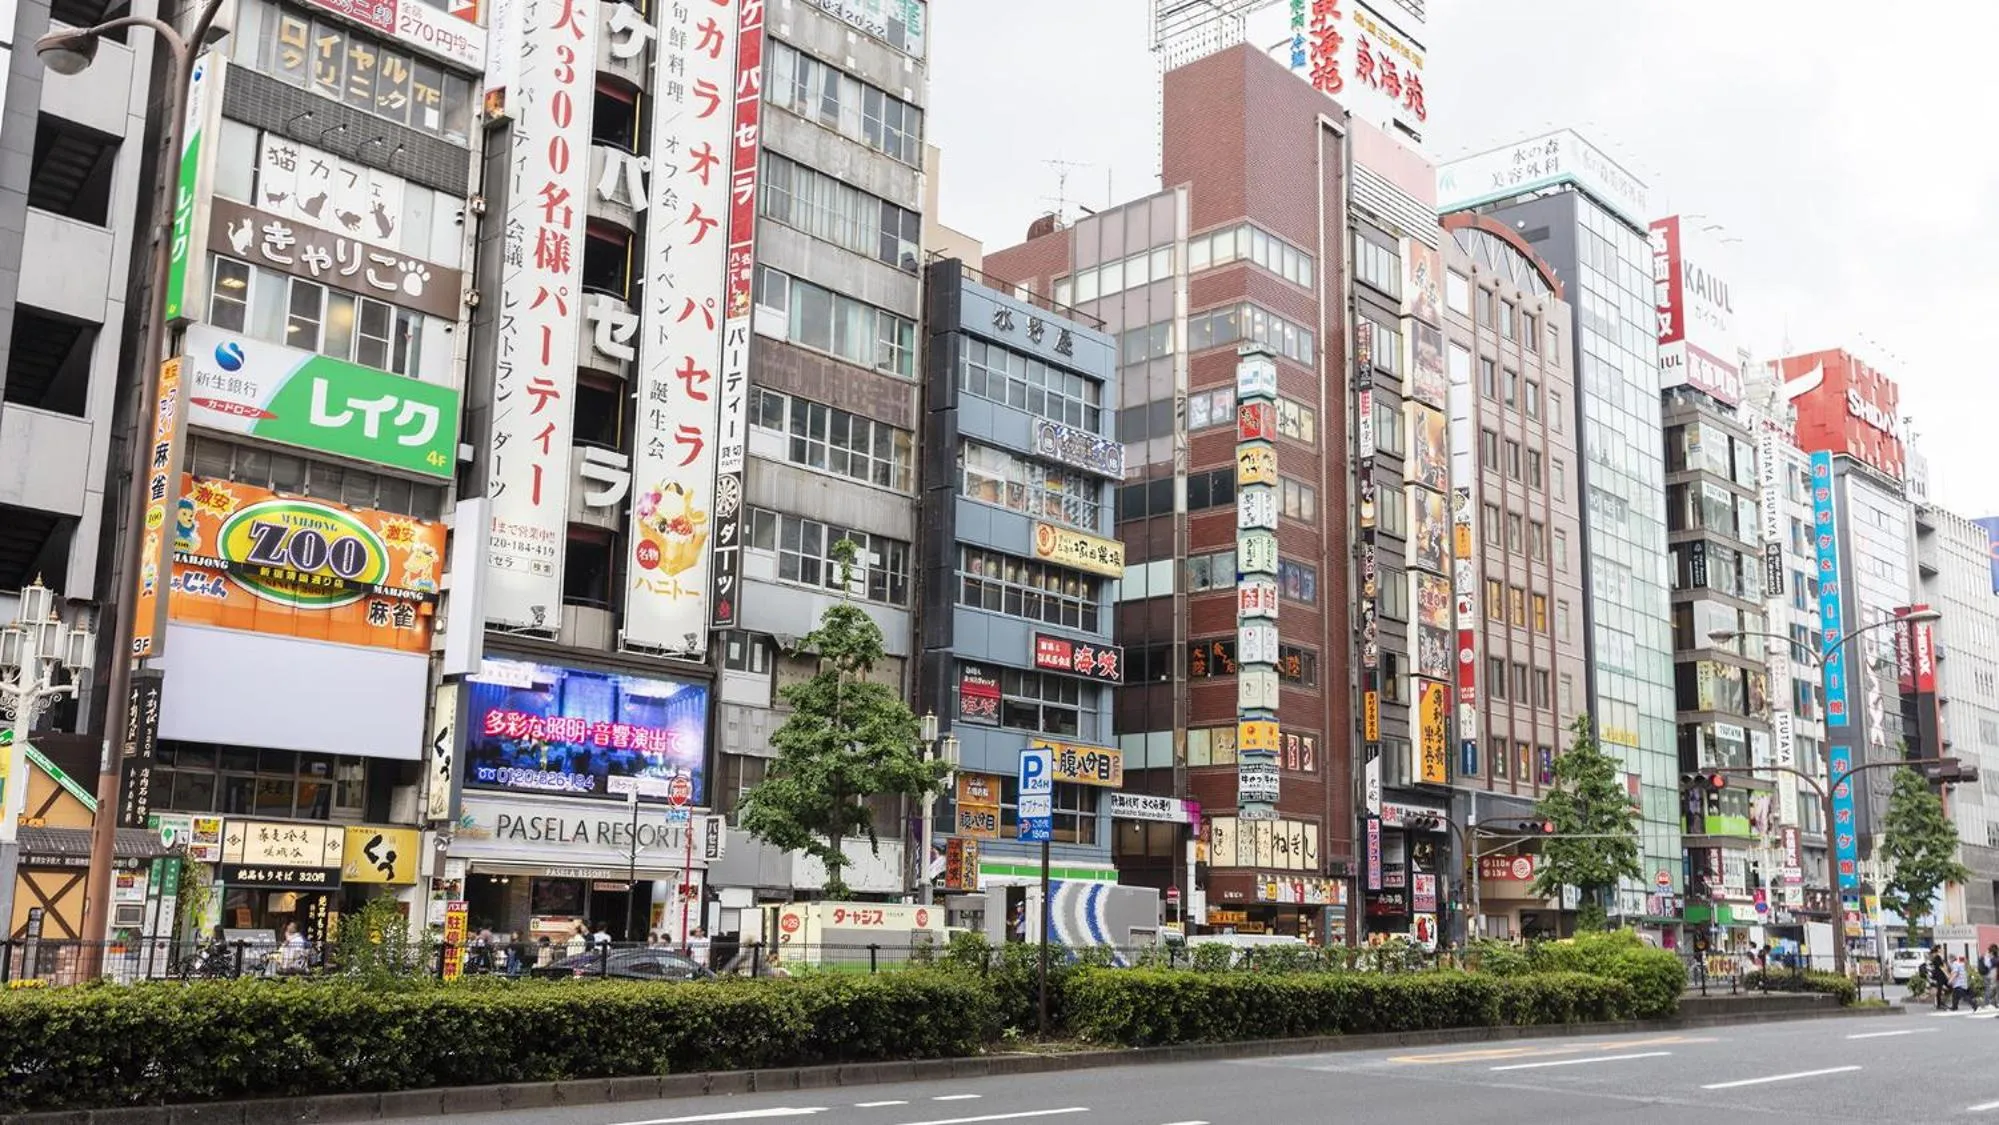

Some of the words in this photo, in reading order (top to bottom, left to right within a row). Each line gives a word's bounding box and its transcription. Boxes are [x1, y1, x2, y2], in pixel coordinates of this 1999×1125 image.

[1356, 34, 1426, 122] 東海苑
[267, 145, 384, 198] 猫カフェ
[1513, 139, 1559, 164] 水の森
[172, 185, 193, 263] レイク
[260, 221, 398, 292] きゃりこ
[1684, 258, 1733, 315] KAIUL
[195, 370, 257, 398] 新生銀行
[207, 399, 262, 418] カードローン
[310, 377, 440, 446] レイク
[152, 443, 171, 500] 麻雀
[426, 450, 447, 468] 4F
[1763, 435, 1774, 482] TSUTAYA
[281, 513, 338, 532] MAHJONG
[1766, 490, 1777, 537] TSUTAYA
[249, 519, 368, 579] ZOO
[717, 522, 737, 596] ダーツ
[368, 600, 416, 628] 麻雀
[373, 585, 423, 601] MAHJONG
[133, 639, 150, 653] 3F
[1780, 713, 1790, 763] TSUTAYA
[1023, 755, 1043, 790] P
[1031, 779, 1049, 789] 24H
[496, 814, 589, 844] PASELA
